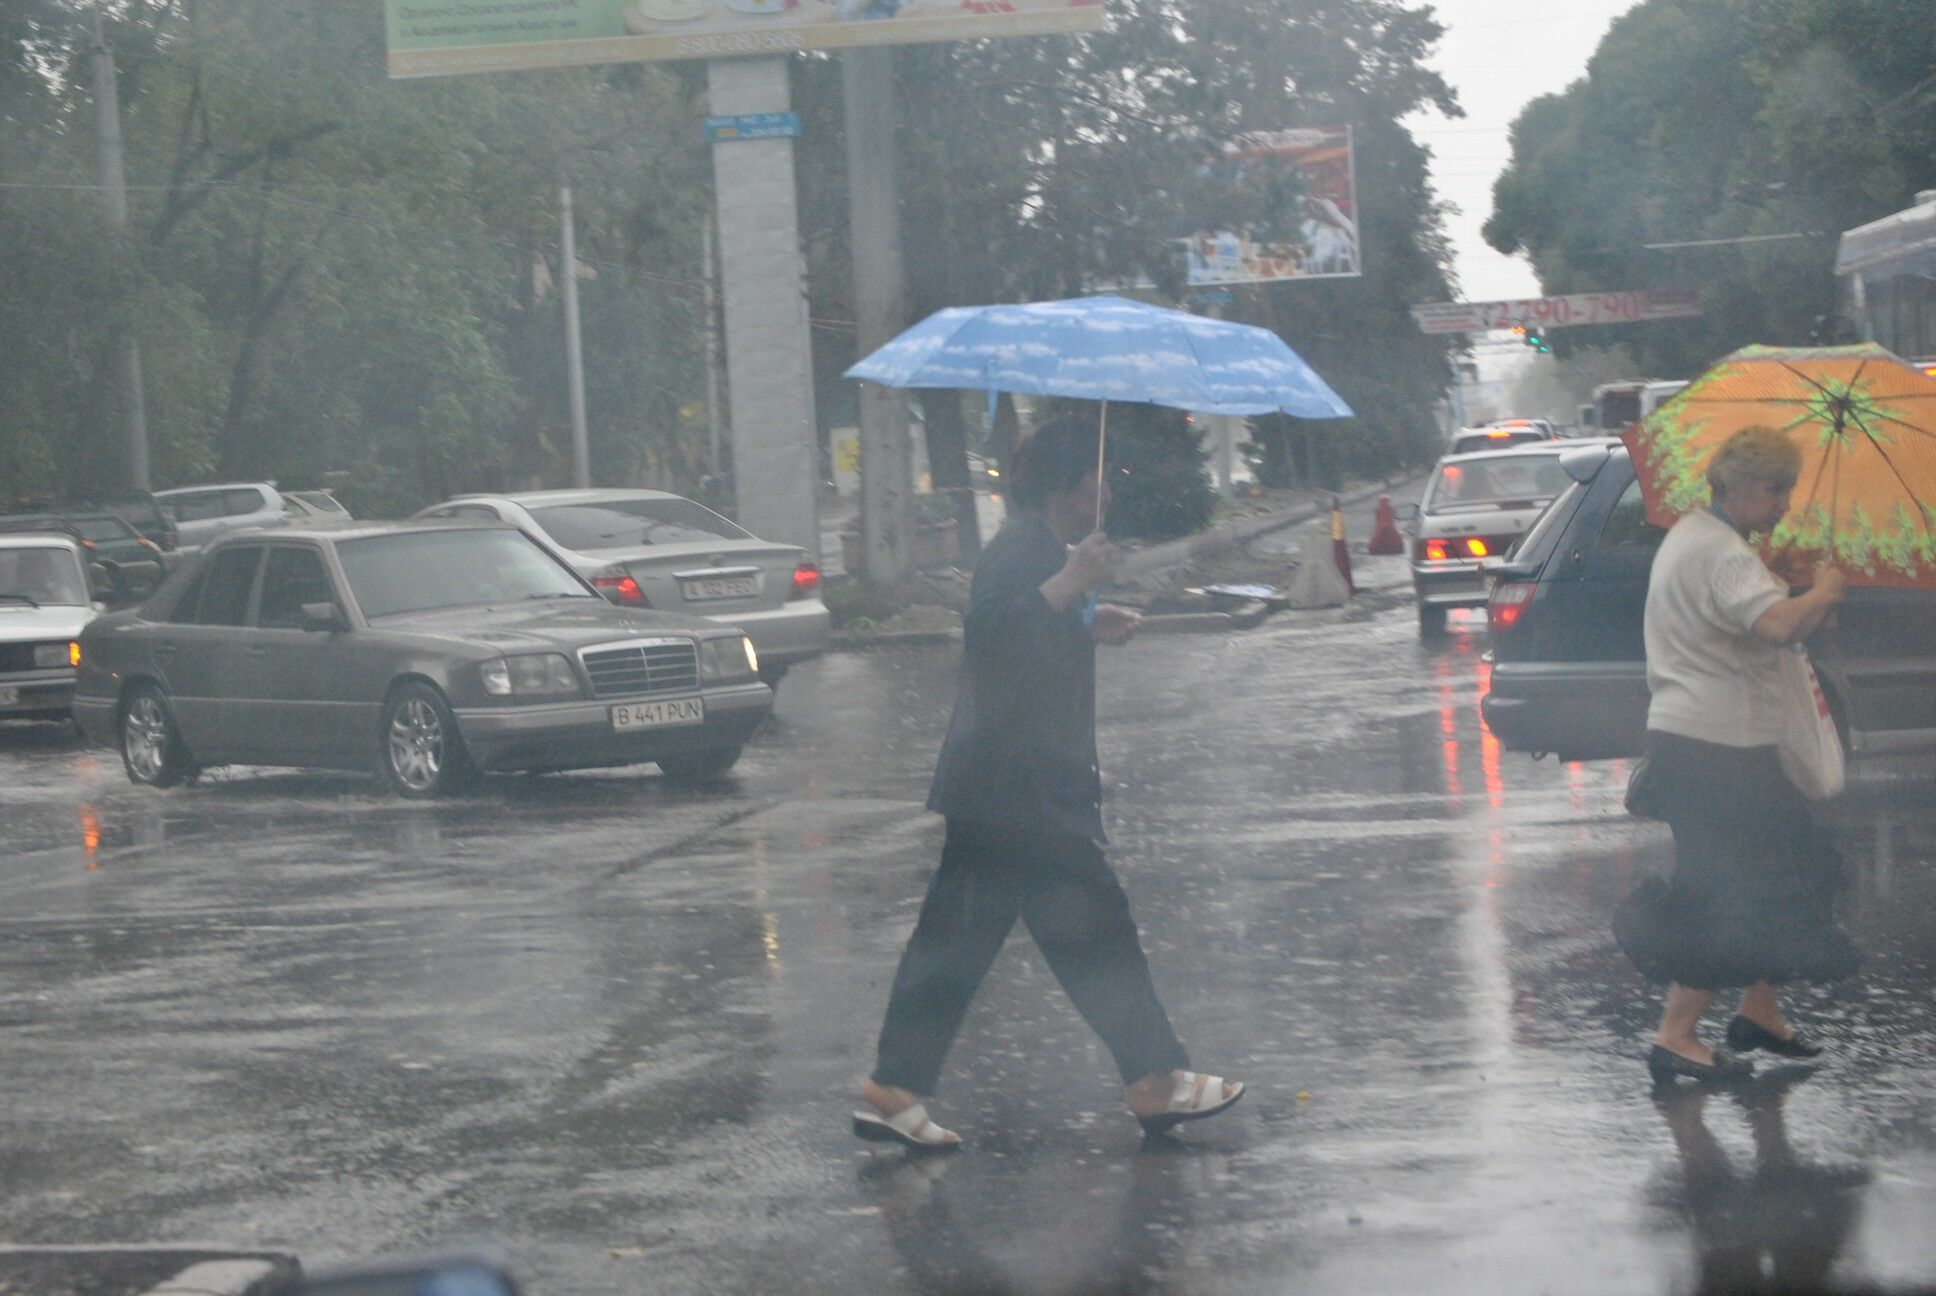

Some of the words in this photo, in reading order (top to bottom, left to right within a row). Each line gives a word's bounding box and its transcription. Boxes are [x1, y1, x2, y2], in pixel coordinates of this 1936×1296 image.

[617, 707, 630, 725] B
[635, 704, 663, 723] 441
[667, 700, 700, 720] PUN
